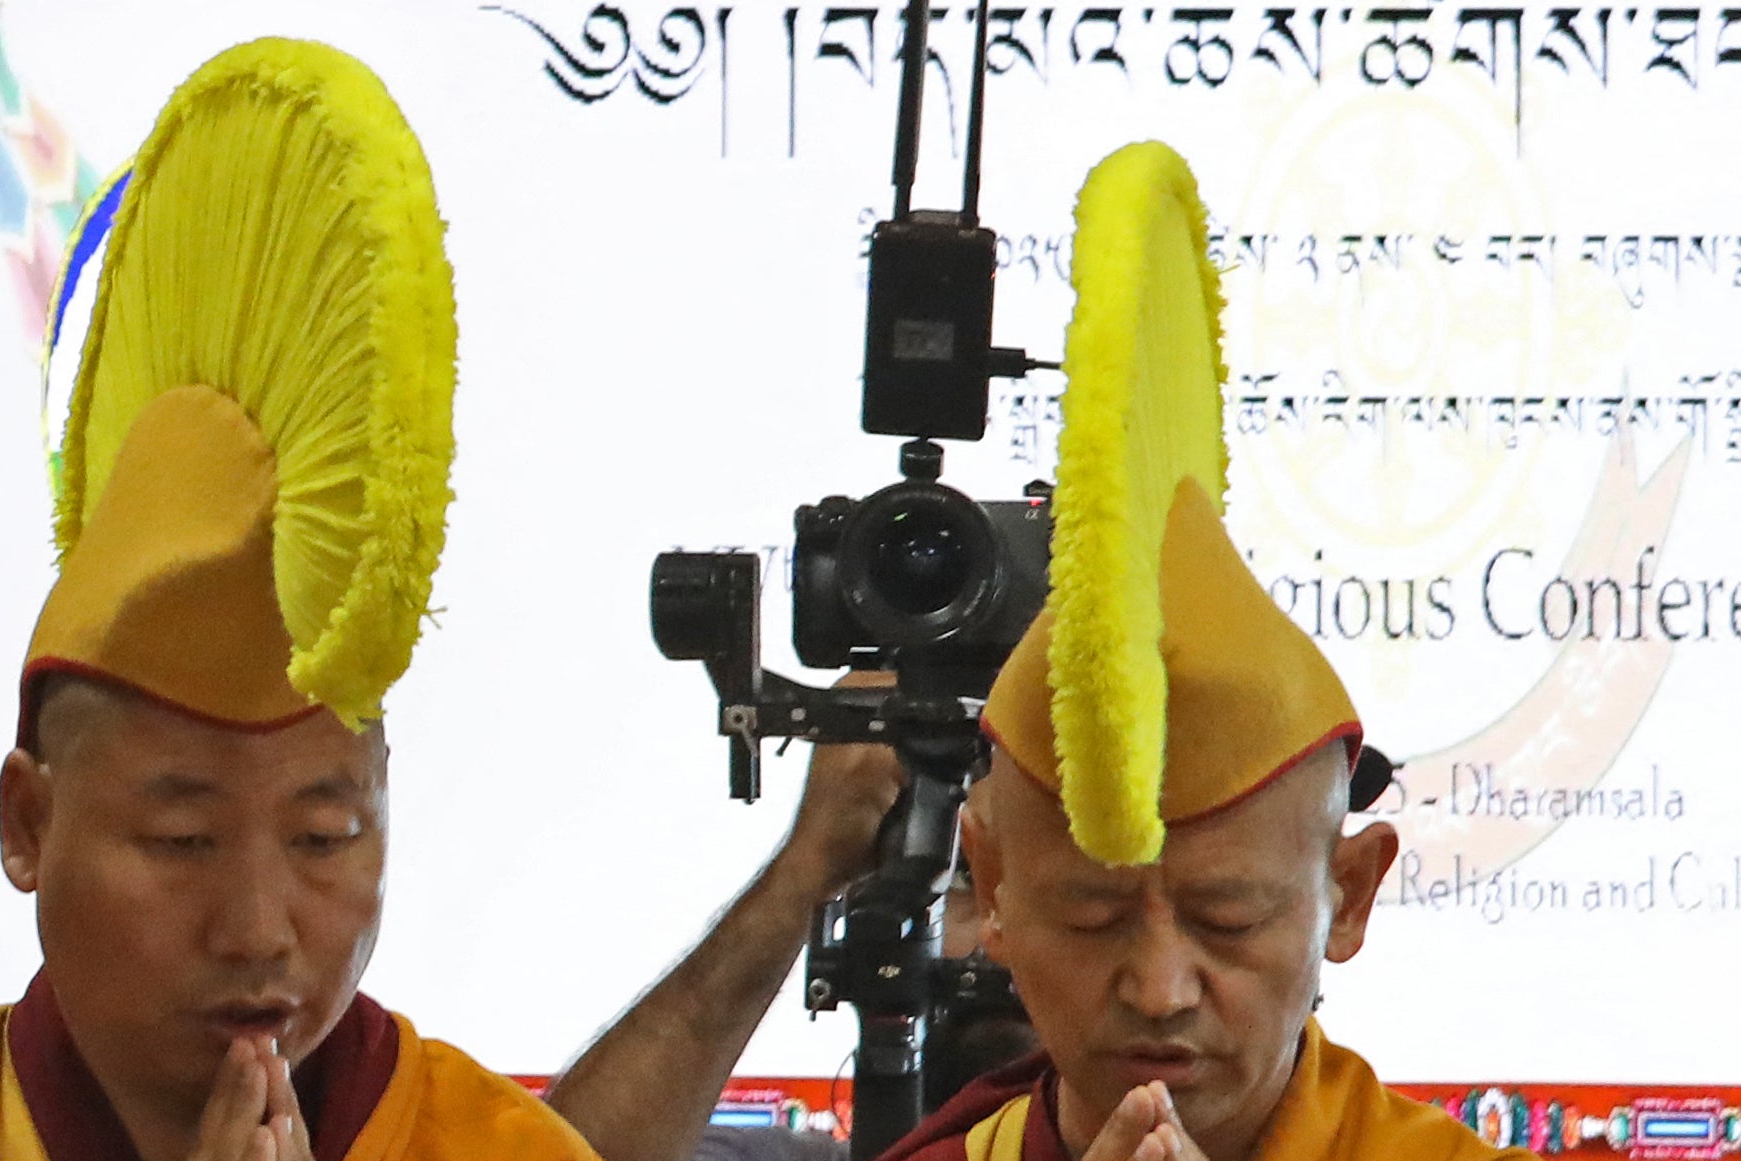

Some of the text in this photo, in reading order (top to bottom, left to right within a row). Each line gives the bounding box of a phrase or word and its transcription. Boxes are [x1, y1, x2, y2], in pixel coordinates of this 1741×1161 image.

[1451, 762, 1684, 821] Dharamsala
[1400, 850, 1567, 925] Religion
[1581, 855, 1655, 913] and
